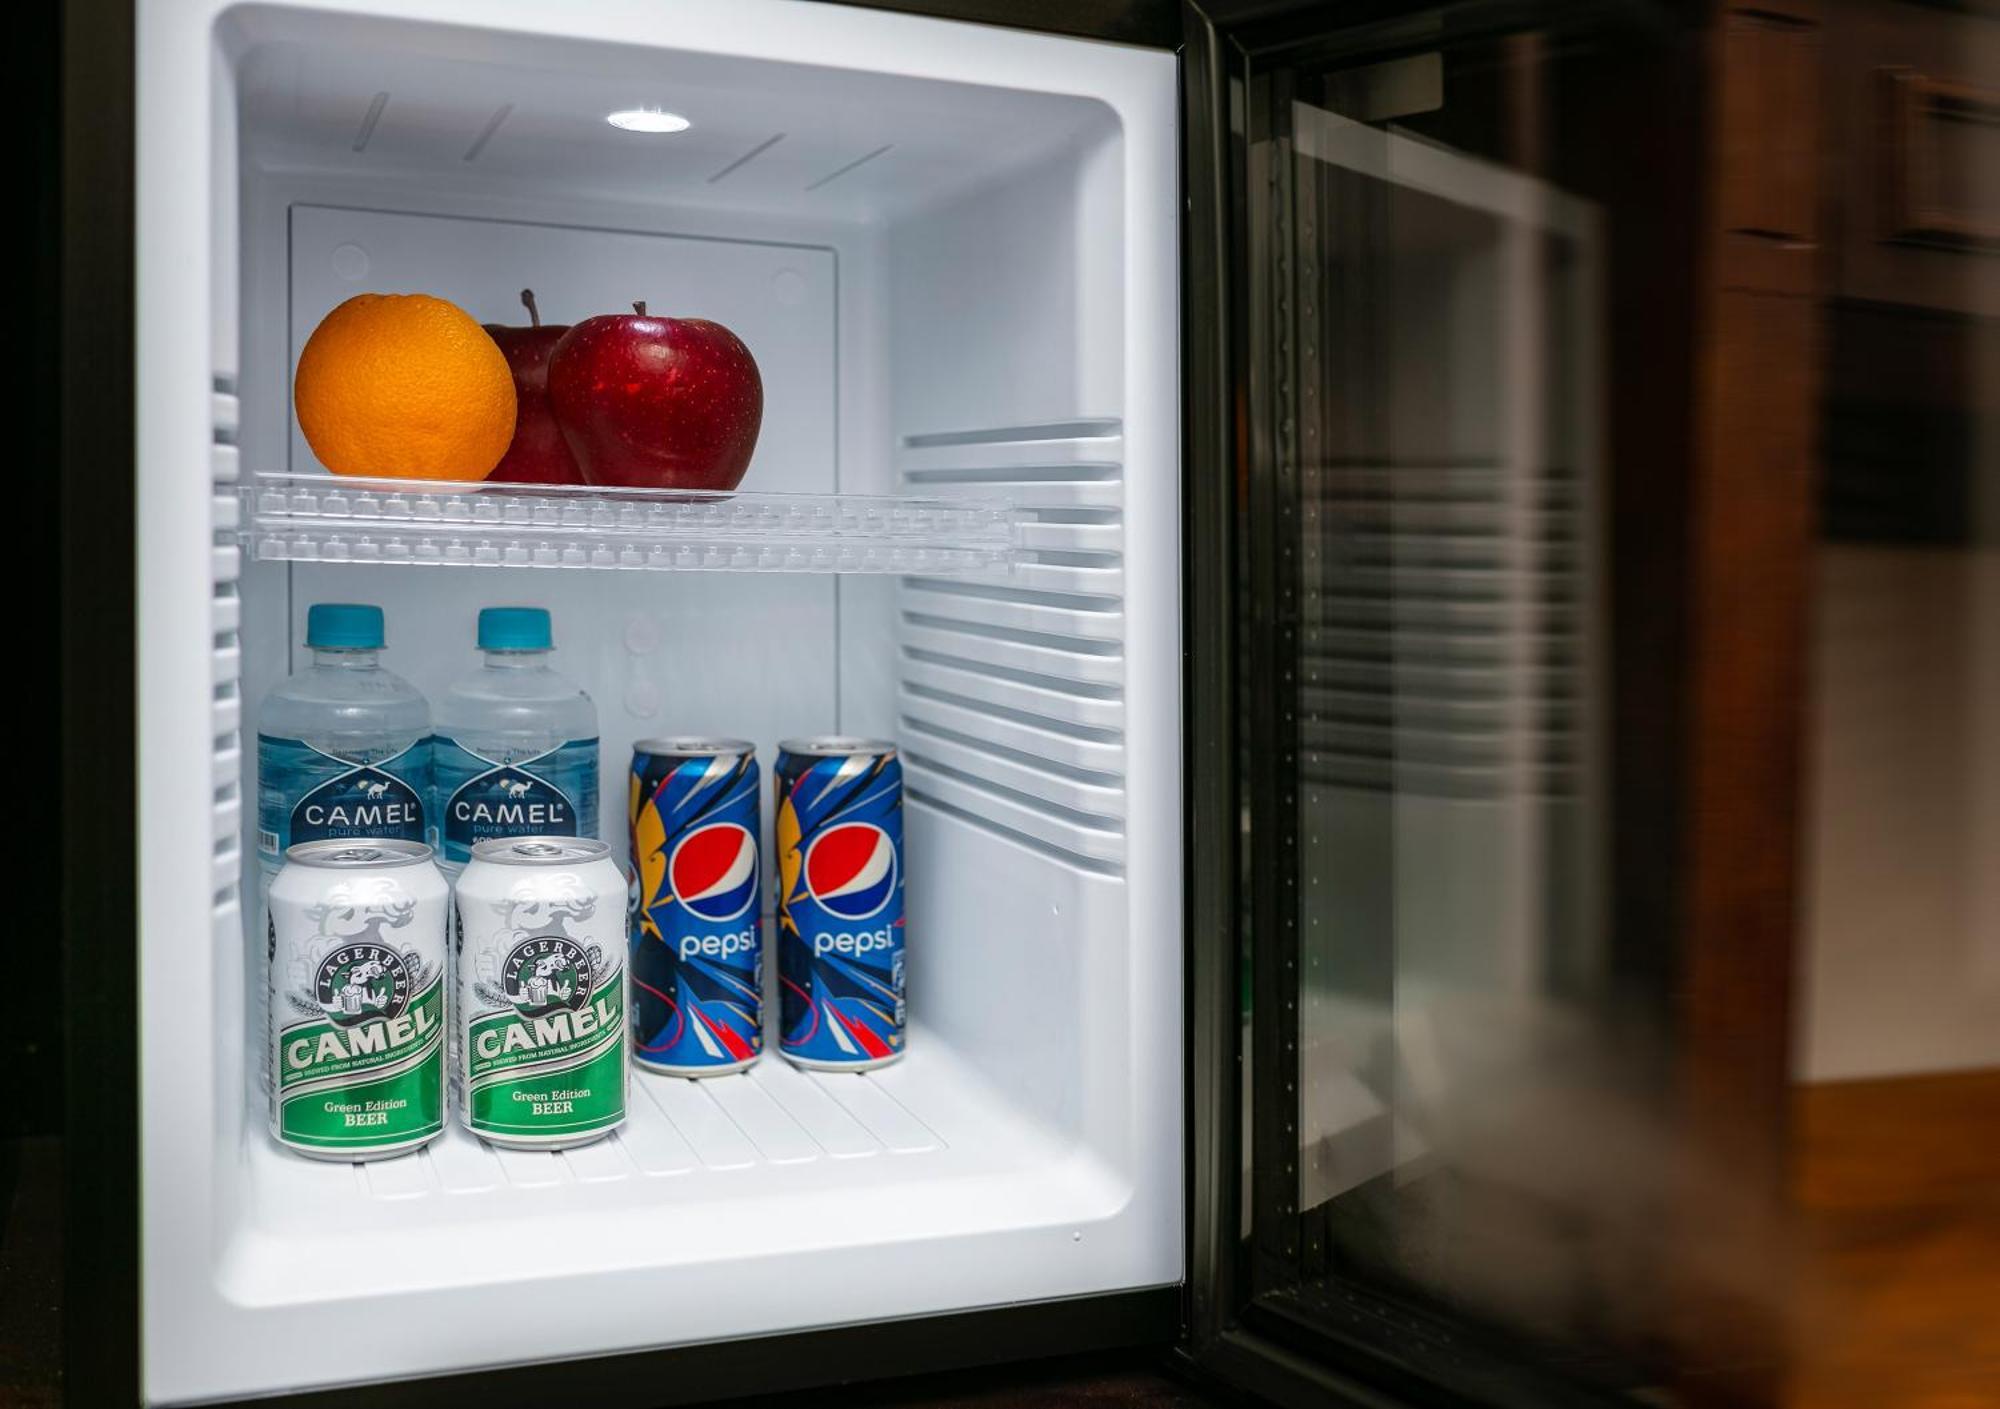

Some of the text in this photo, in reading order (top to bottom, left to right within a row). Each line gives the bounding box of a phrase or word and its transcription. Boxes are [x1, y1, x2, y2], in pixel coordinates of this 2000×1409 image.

[328, 826, 400, 837] pure water
[474, 823, 544, 834] pure water
[680, 924, 756, 961] pepsi
[814, 923, 893, 958] pepsi
[476, 998, 617, 1059] CAMEL
[287, 1005, 436, 1069] CAMEL
[518, 1053, 538, 1062] FROM
[538, 1047, 568, 1058] NATURAL
[331, 1062, 351, 1072] FROM
[351, 1056, 384, 1067] NATURAL
[512, 1088, 592, 1102] Green Edition
[324, 1099, 407, 1113] Green Edition
[532, 1101, 574, 1115] BEER
[344, 1112, 388, 1127] BEER
